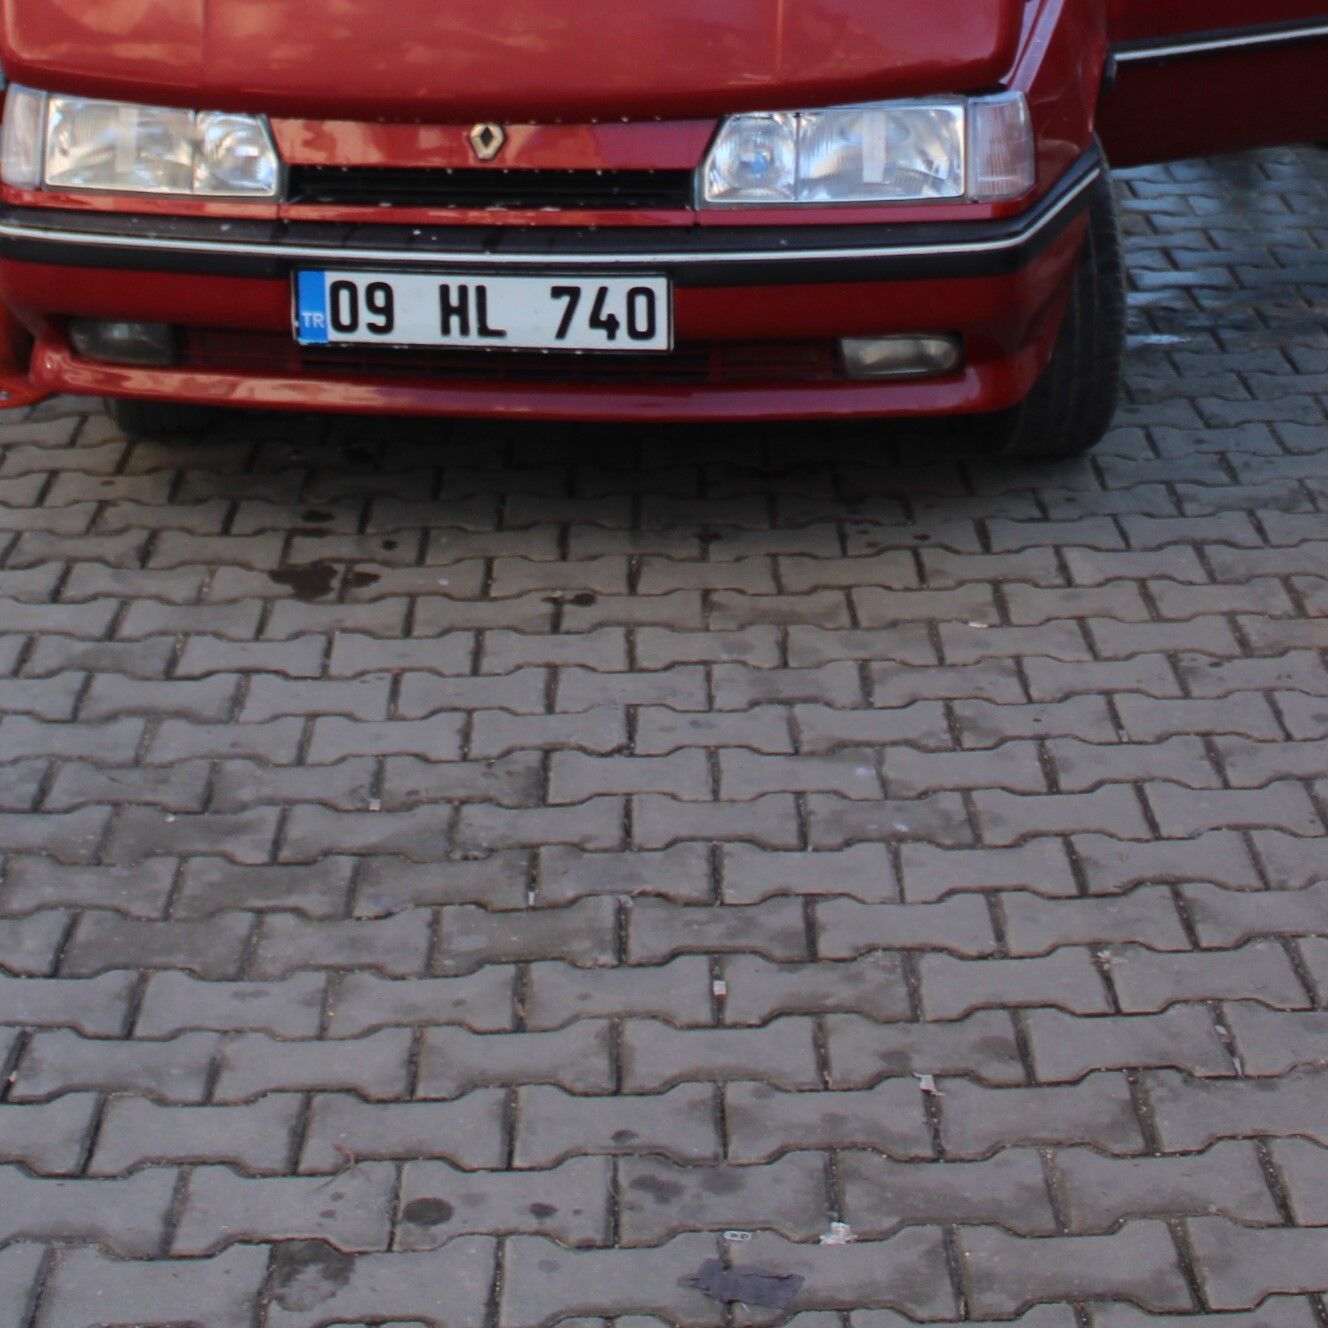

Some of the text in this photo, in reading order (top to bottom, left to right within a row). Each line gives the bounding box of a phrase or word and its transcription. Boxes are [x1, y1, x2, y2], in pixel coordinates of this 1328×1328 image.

[302, 311, 325, 329] TR
[329, 280, 656, 342] 09 HL 740
